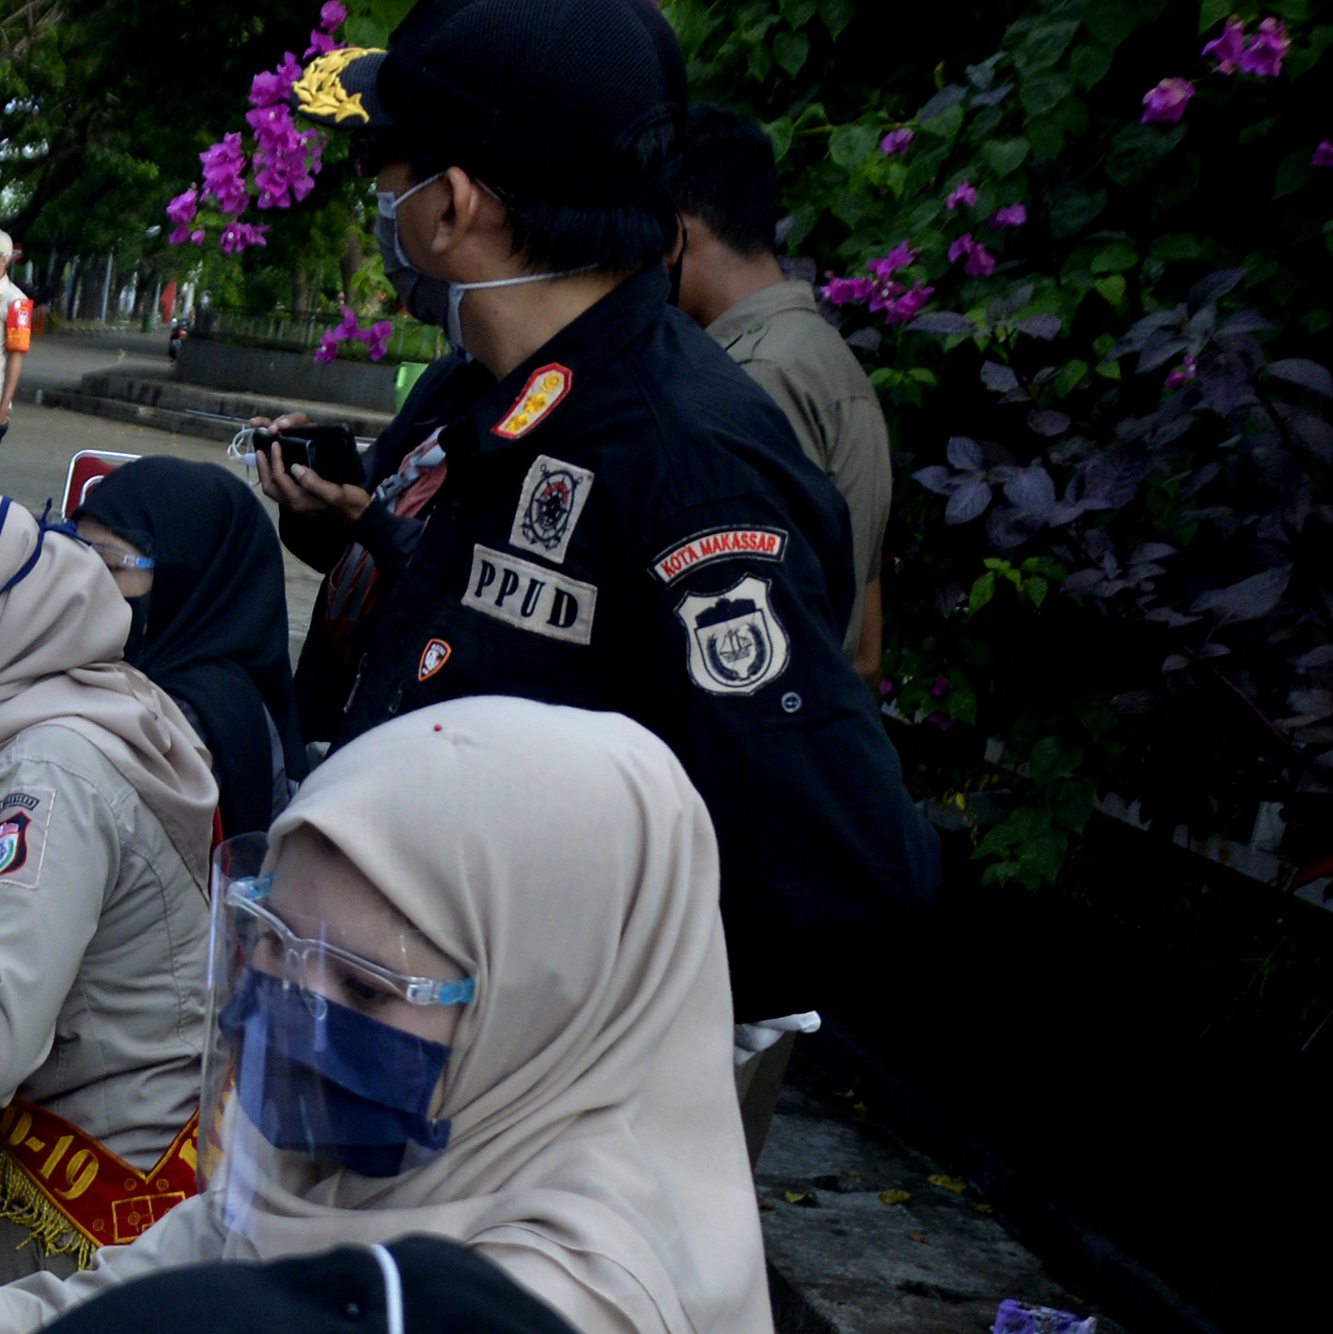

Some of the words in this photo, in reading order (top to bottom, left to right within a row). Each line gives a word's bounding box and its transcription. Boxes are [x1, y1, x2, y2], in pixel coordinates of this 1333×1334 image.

[661, 546, 700, 578] KOTA
[699, 532, 777, 557] MAKASSAR
[474, 559, 579, 628] PPUD
